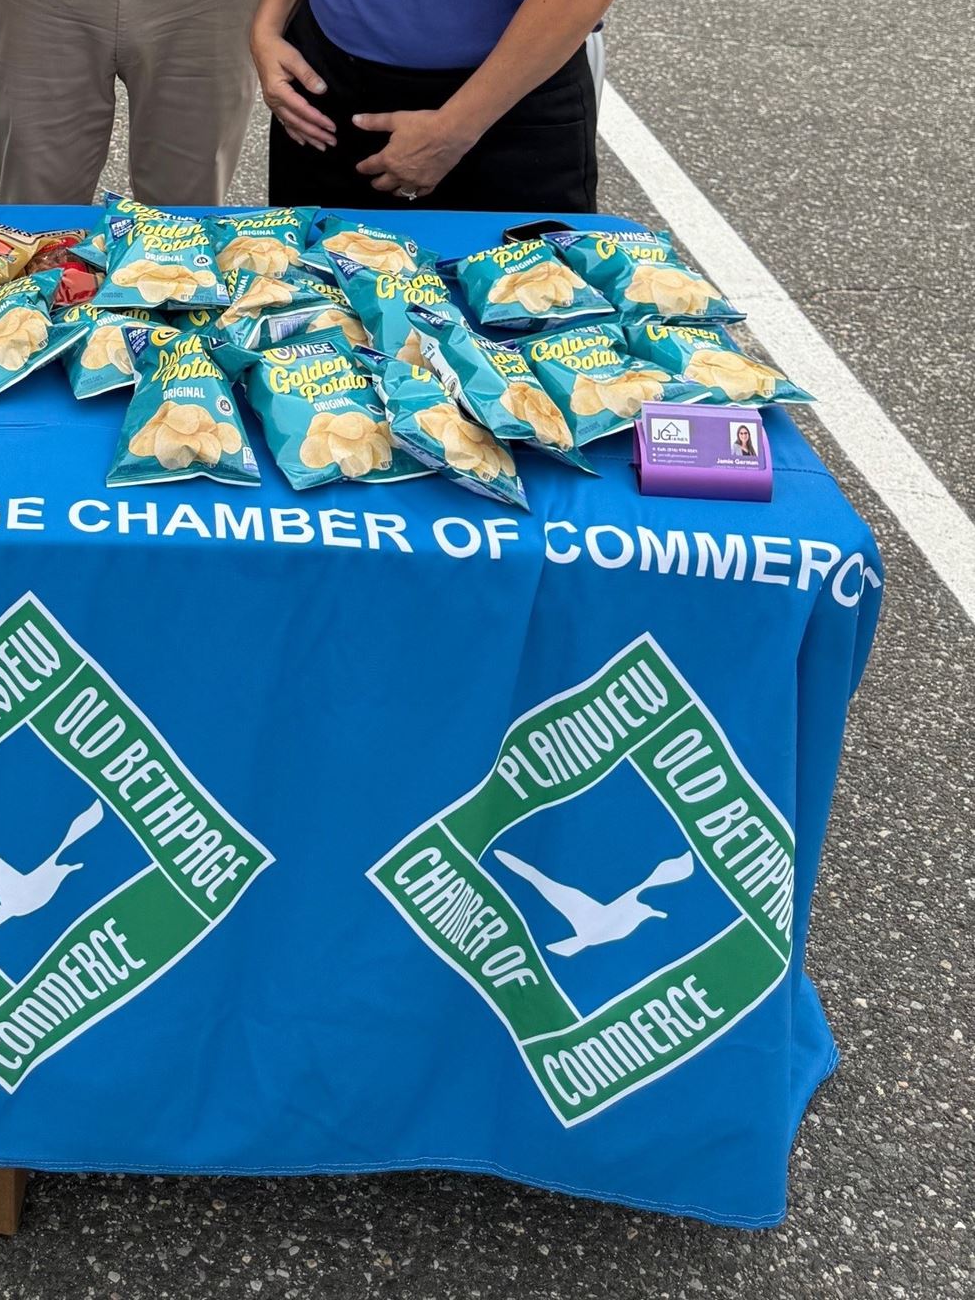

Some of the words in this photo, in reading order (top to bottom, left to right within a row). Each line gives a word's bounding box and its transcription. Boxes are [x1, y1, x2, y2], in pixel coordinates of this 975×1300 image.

[127, 222, 207, 246] Golden
[235, 216, 301, 230] Potato
[358, 228, 397, 240] ORIGINAL
[142, 234, 209, 253] Potato
[622, 231, 655, 243] WISE
[145, 252, 185, 262] ORIGINAL
[504, 254, 544, 274] ORIGINAL
[232, 274, 250, 305] IGINAL
[297, 342, 334, 357] WISE
[269, 355, 352, 394] Golden
[163, 387, 206, 401] ORIGINAL
[299, 374, 367, 403] Potato
[67, 498, 414, 554] CHAMBER
[433, 516, 520, 560] OF
[497, 659, 668, 801] PLAINVIEW
[54, 686, 127, 759] OLD
[100, 738, 249, 903] BETHPAGE
[652, 728, 728, 804] OLD
[695, 797, 794, 942] BETHPA
[393, 847, 509, 961] CHAMBER
[486, 944, 539, 988] OF
[542, 974, 725, 1106] COMMERCE
